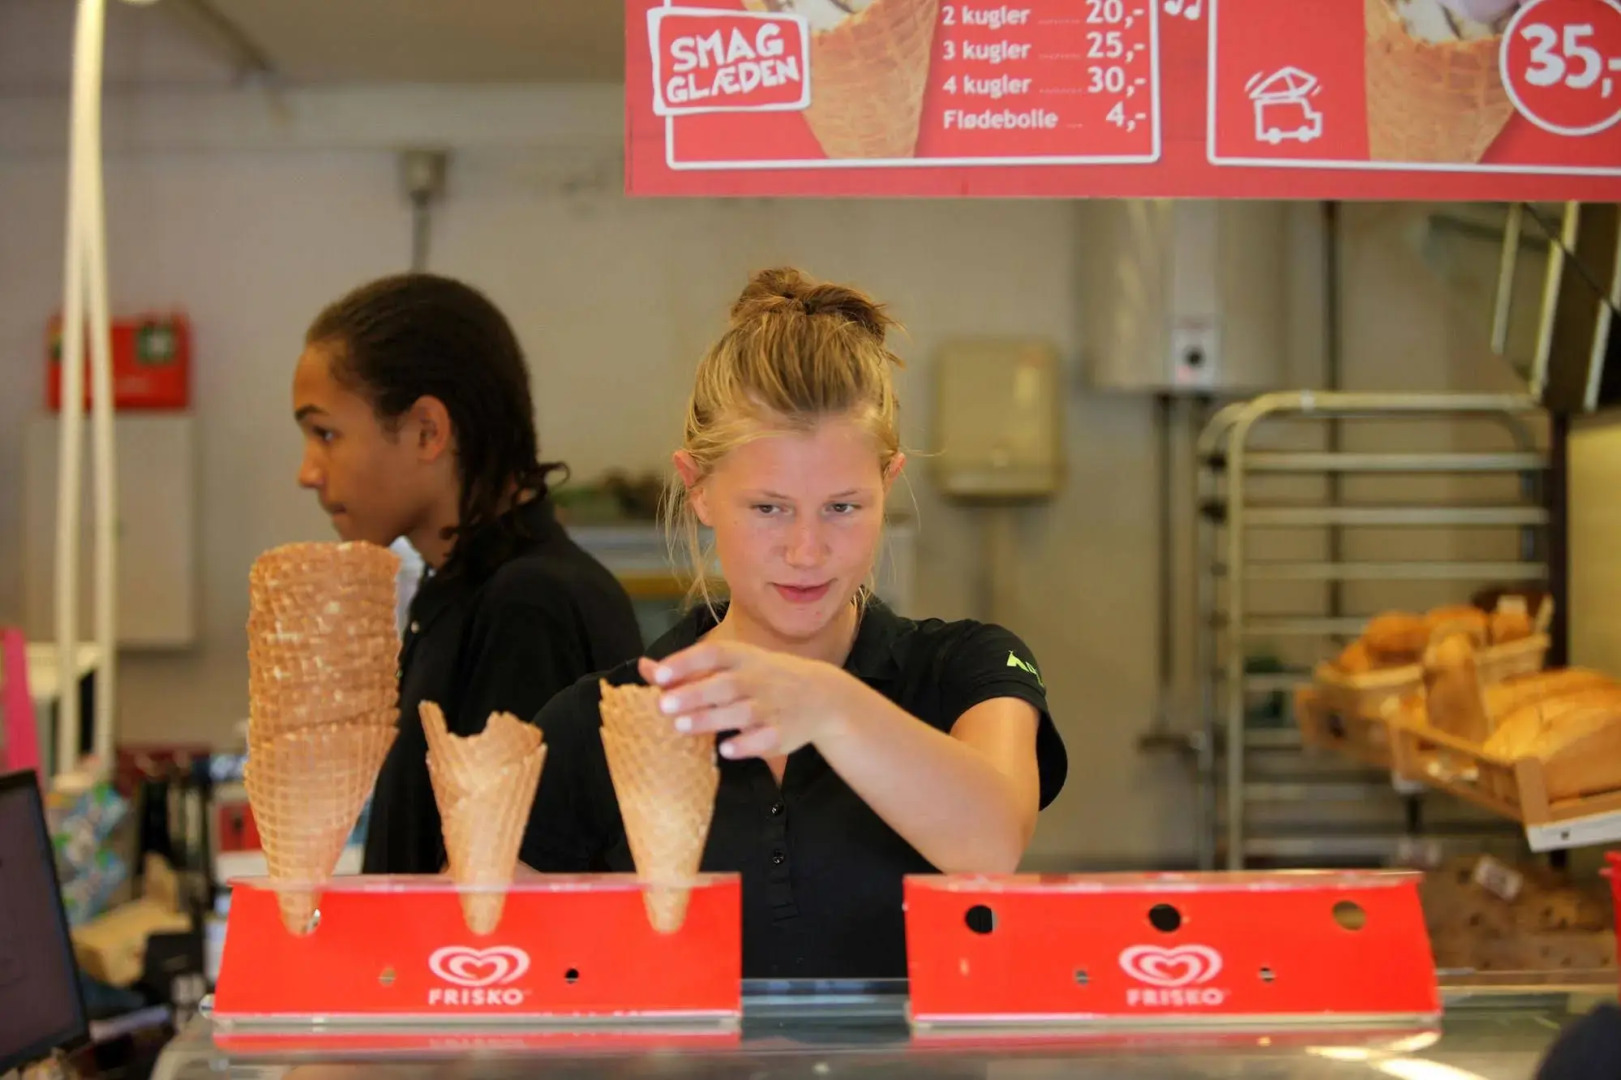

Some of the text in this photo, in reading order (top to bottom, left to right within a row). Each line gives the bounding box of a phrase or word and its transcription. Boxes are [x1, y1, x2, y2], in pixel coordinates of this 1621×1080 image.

[943, 0, 1144, 29] 2 kugler 20,-
[670, 22, 785, 73] SMAG
[943, 31, 1145, 64] 3 kugler 25,-
[1520, 23, 1621, 98] 35,-
[665, 54, 801, 104] GLÆDEN
[942, 66, 1146, 99] 4 kugler 30,-
[943, 101, 1146, 131] Flødebolle 4,-
[428, 988, 523, 1005] FRISKO
[1127, 988, 1223, 1005] FRISKO
